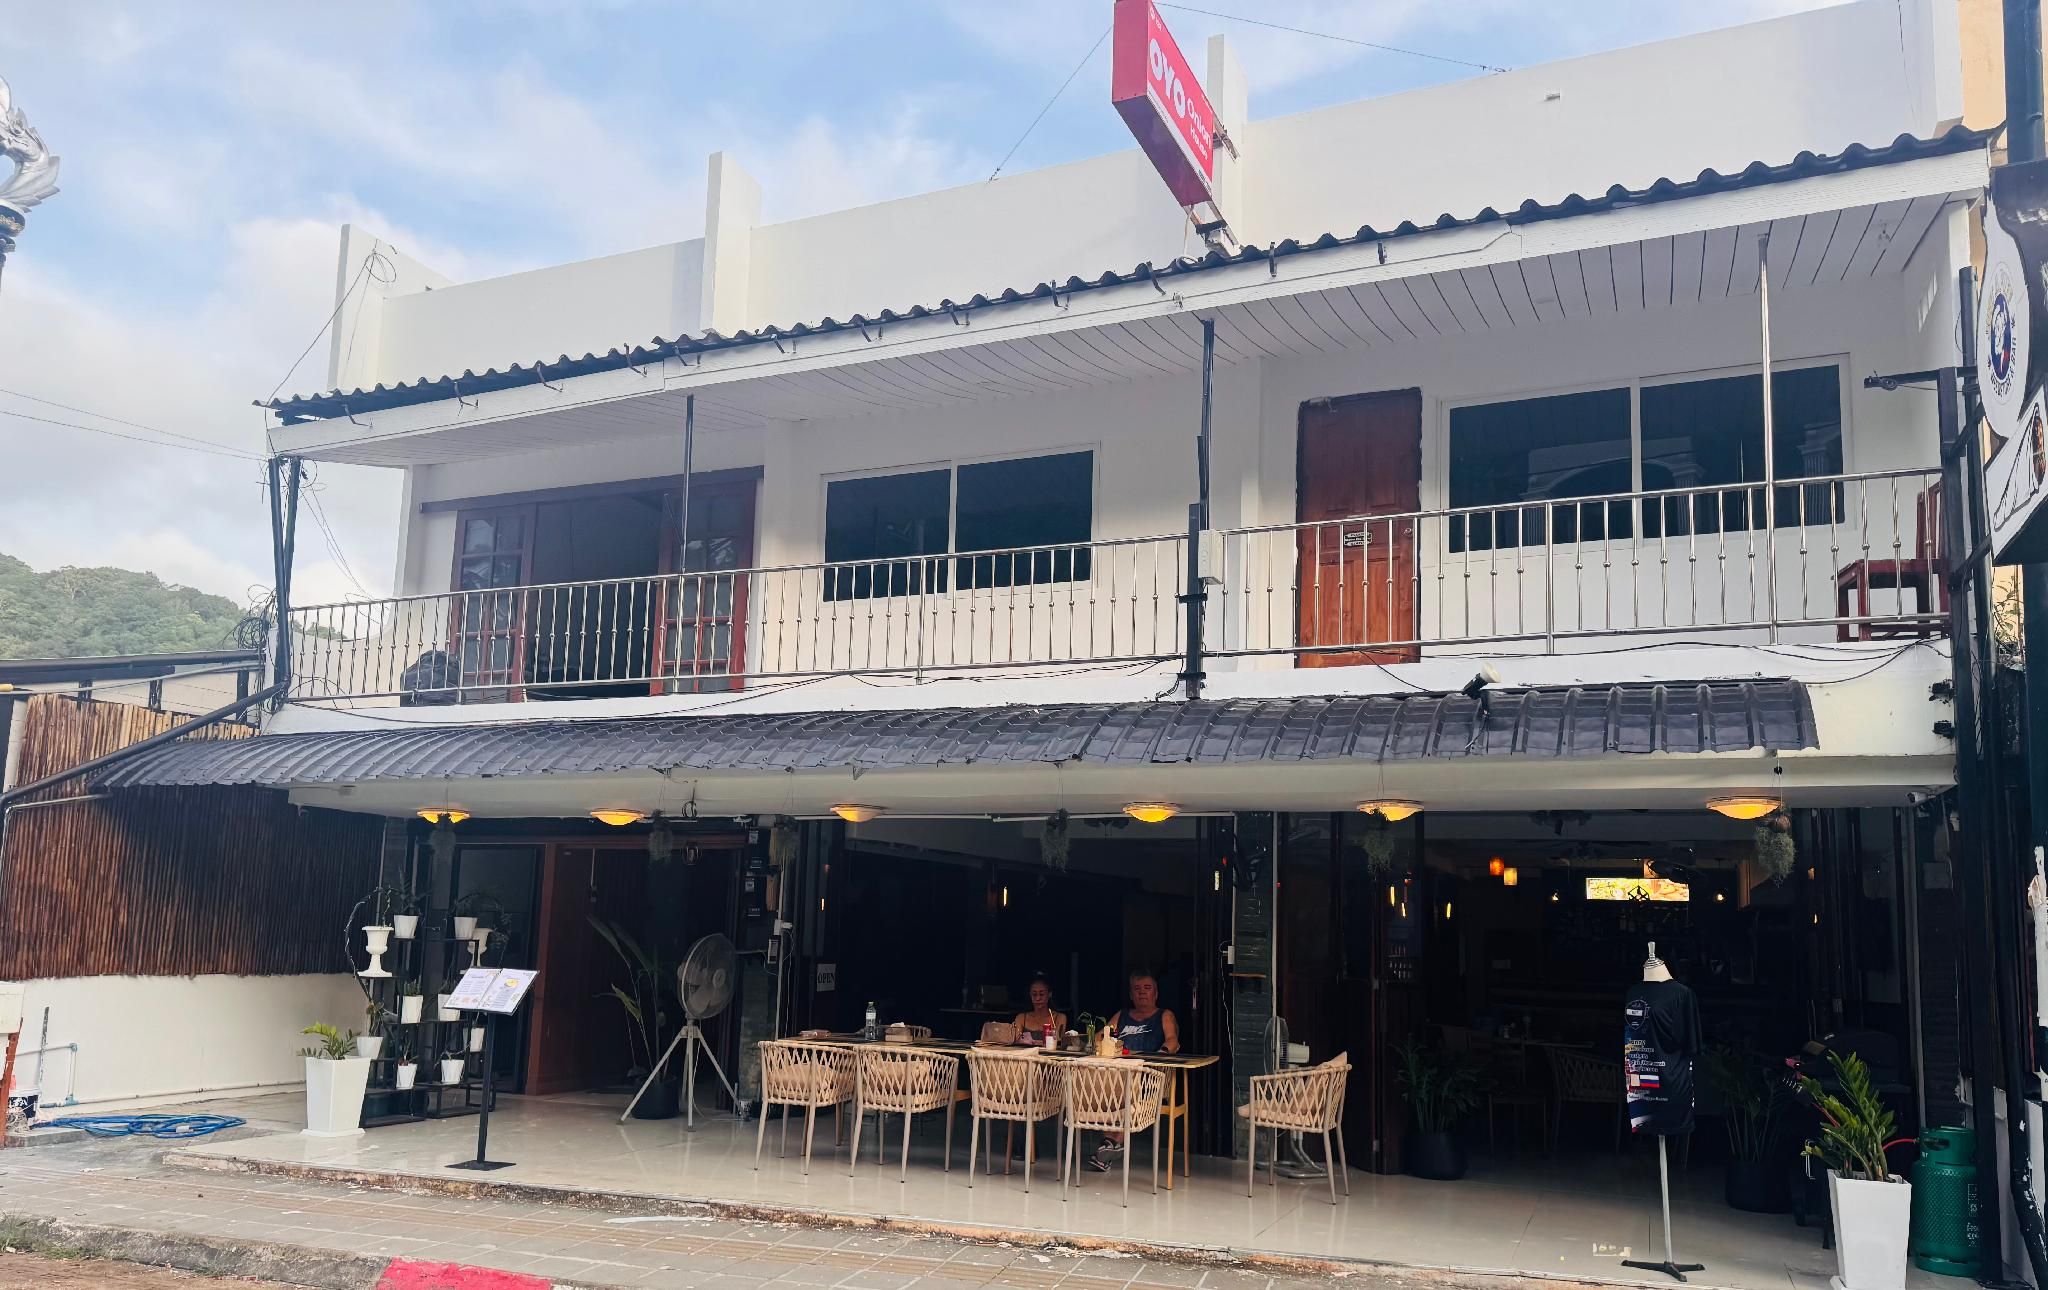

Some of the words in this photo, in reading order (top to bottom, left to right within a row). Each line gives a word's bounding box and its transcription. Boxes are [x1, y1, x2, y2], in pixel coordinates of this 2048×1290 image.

[1149, 38, 1186, 118] OYO
[1187, 97, 1211, 150] Onion
[817, 972, 835, 984] OPEN
